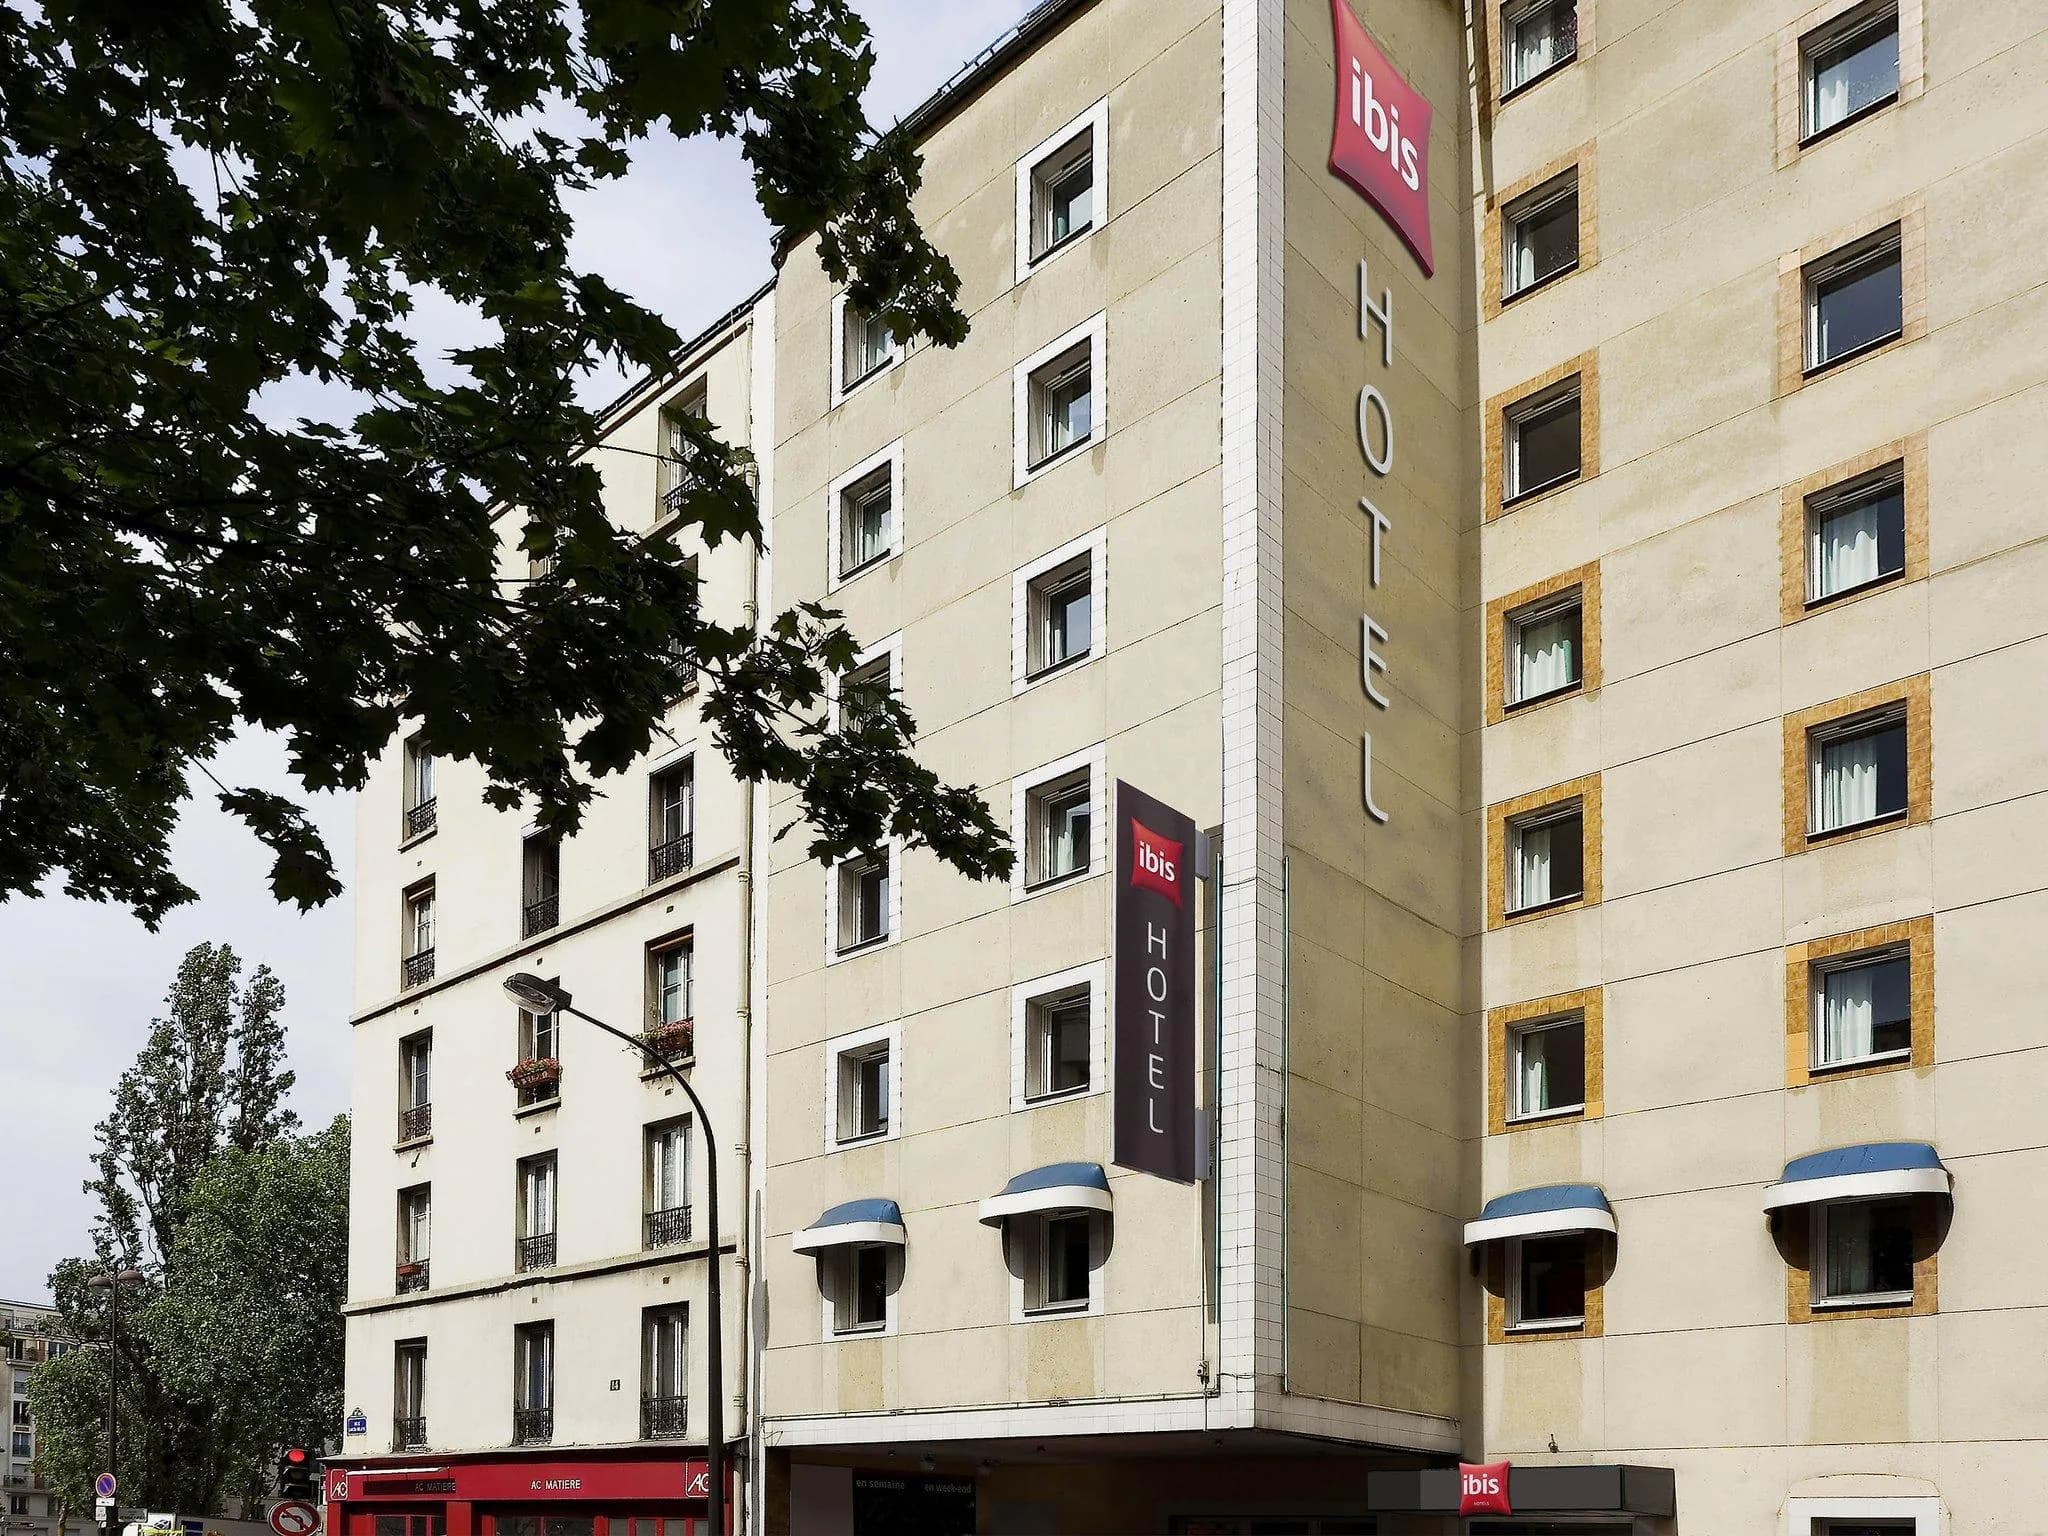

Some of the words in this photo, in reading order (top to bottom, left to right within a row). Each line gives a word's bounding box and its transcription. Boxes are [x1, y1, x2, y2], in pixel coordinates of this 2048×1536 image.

[1351, 55, 1420, 192] ibis
[1358, 258, 1393, 822] HOTEL
[1139, 839, 1176, 883] ibis
[1146, 921, 1169, 1135] HOTEL
[530, 1480, 542, 1490] AC
[545, 1479, 581, 1490] MATIERE
[1463, 1474, 1500, 1495] ibis
